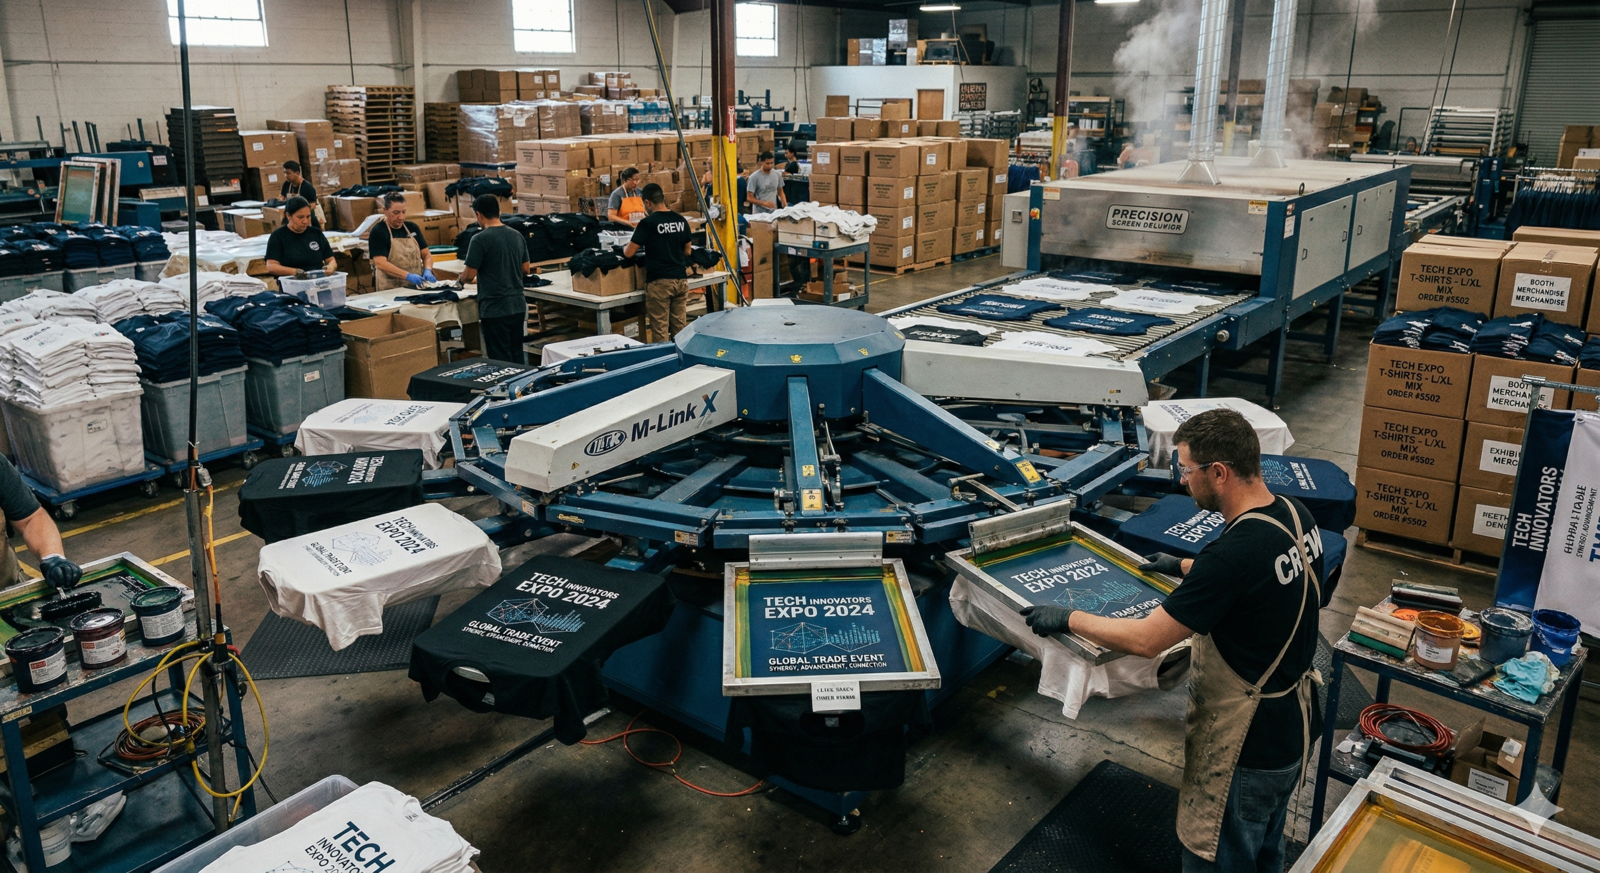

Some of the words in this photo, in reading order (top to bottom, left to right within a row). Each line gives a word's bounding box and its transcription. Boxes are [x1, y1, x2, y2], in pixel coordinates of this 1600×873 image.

[1112, 209, 1183, 223] PRECISION
[1112, 219, 1141, 227] SCREEN
[657, 221, 685, 234] CREW
[1421, 264, 1445, 274] TECH
[1447, 267, 1473, 277] EXPO
[1410, 273, 1452, 285] T-SHIRTS
[1460, 278, 1482, 288] L/XL
[1530, 279, 1554, 287] BOOTH
[1418, 293, 1444, 302] ORDER
[1436, 285, 1453, 295] MIX
[1516, 286, 1565, 297] MERCHANDISE
[1515, 295, 1565, 306] MERCHANDISE
[1390, 360, 1415, 370] TECH
[1417, 363, 1445, 374] EXPO
[1379, 368, 1423, 382] T-SHIRTS
[1430, 375, 1453, 386] L/XL
[1405, 381, 1423, 391] MIX
[1387, 389, 1413, 399] ORDER
[631, 403, 697, 442] M-Link
[700, 390, 719, 418] X
[1384, 422, 1409, 433] TECH
[1411, 426, 1438, 438] EXPO
[1373, 430, 1416, 444] T-SHIRTS
[1424, 438, 1447, 449] L/XL
[1381, 450, 1408, 461] ORDER
[1400, 444, 1418, 454] MIX
[1377, 483, 1401, 494] TECH
[1403, 488, 1429, 500] EXPO
[1365, 490, 1407, 505] T-SHIRTS
[1415, 499, 1438, 511] L/XL
[1373, 511, 1400, 522] ORDER
[1391, 505, 1409, 515] MIX
[1529, 466, 1558, 552] INNOVATORS
[1164, 522, 1191, 537] TECH
[1181, 525, 1212, 543] EXPO
[1512, 513, 1532, 547] TECH
[375, 521, 405, 538] EXPO
[395, 537, 426, 554] 2024
[1274, 525, 1324, 586] CREW
[1011, 567, 1050, 584] TECH
[1048, 557, 1097, 575] INNOVATORS
[1024, 574, 1069, 593] EXPO
[1066, 563, 1110, 581] 2024
[530, 572, 569, 587] TECH
[565, 582, 620, 600] INNOVATORS
[515, 580, 564, 599] EXPO
[561, 591, 612, 610] 2024
[763, 596, 807, 606] TECH
[809, 597, 872, 605] INNOVATORS
[764, 606, 818, 619] EXPO
[823, 604, 875, 617] 2024
[468, 620, 502, 634] GLOBAL
[502, 627, 533, 641] TRADE
[531, 635, 563, 648] EVENT
[768, 656, 811, 666] GLOBAL
[812, 655, 848, 663] TRADE
[850, 653, 885, 662] EVENT
[332, 820, 396, 873] TECH
[304, 844, 330, 868] EXPO
[316, 837, 365, 873] INNOVATO
